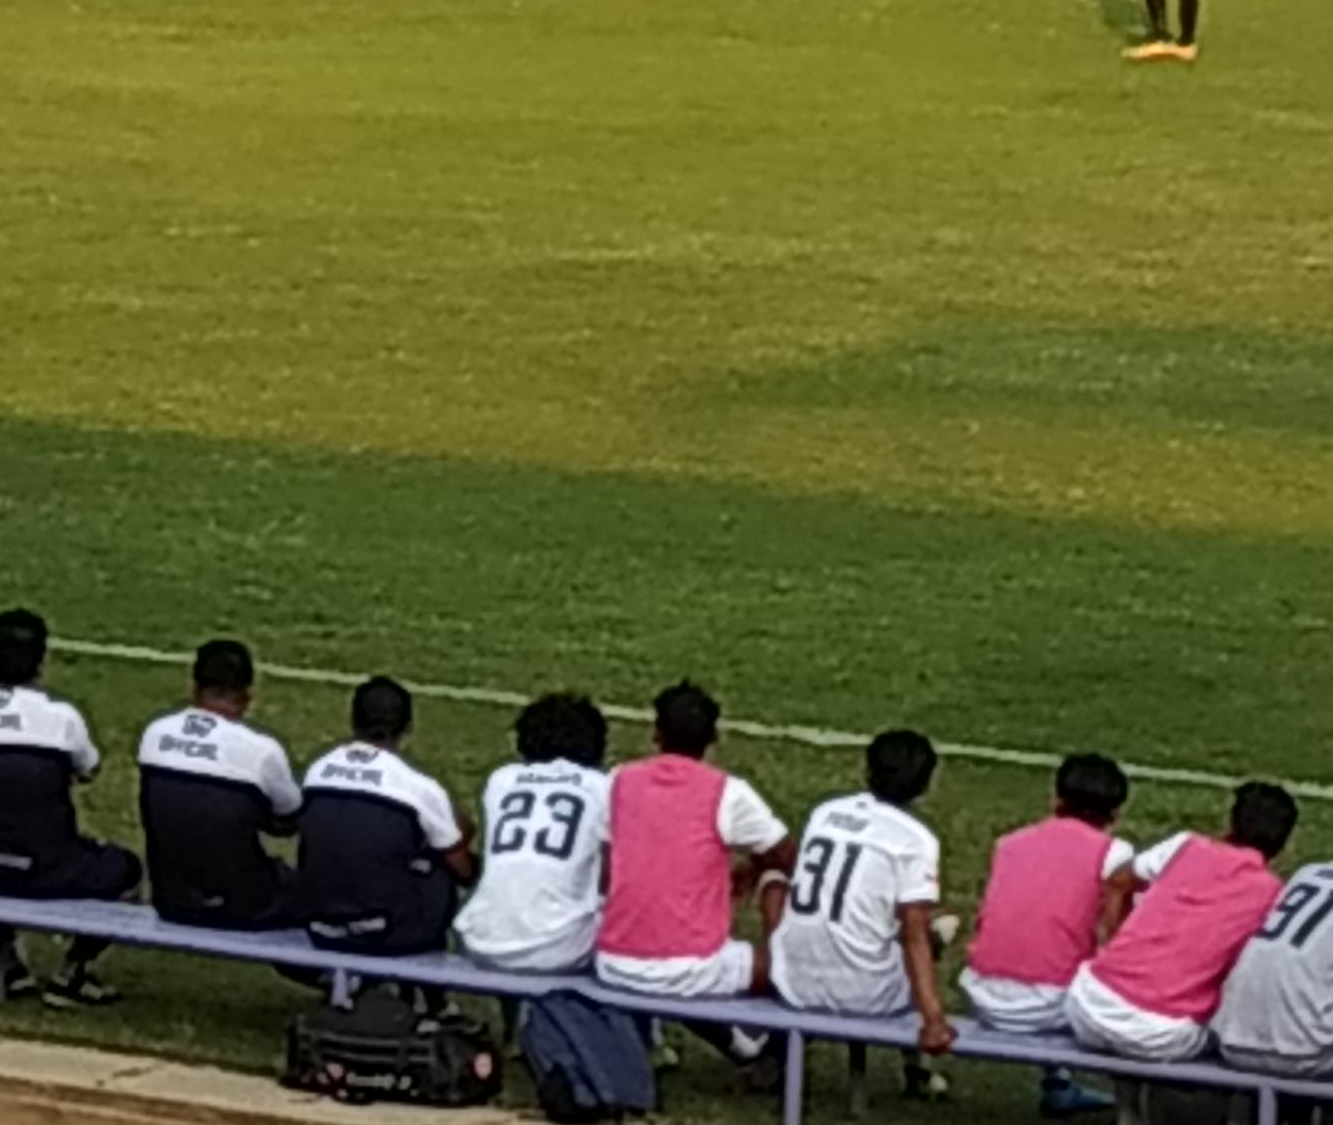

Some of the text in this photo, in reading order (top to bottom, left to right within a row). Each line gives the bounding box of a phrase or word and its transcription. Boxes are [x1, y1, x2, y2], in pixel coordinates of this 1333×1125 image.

[490, 789, 585, 861] 23
[790, 836, 863, 922] 31
[1254, 882, 1333, 950] 91
